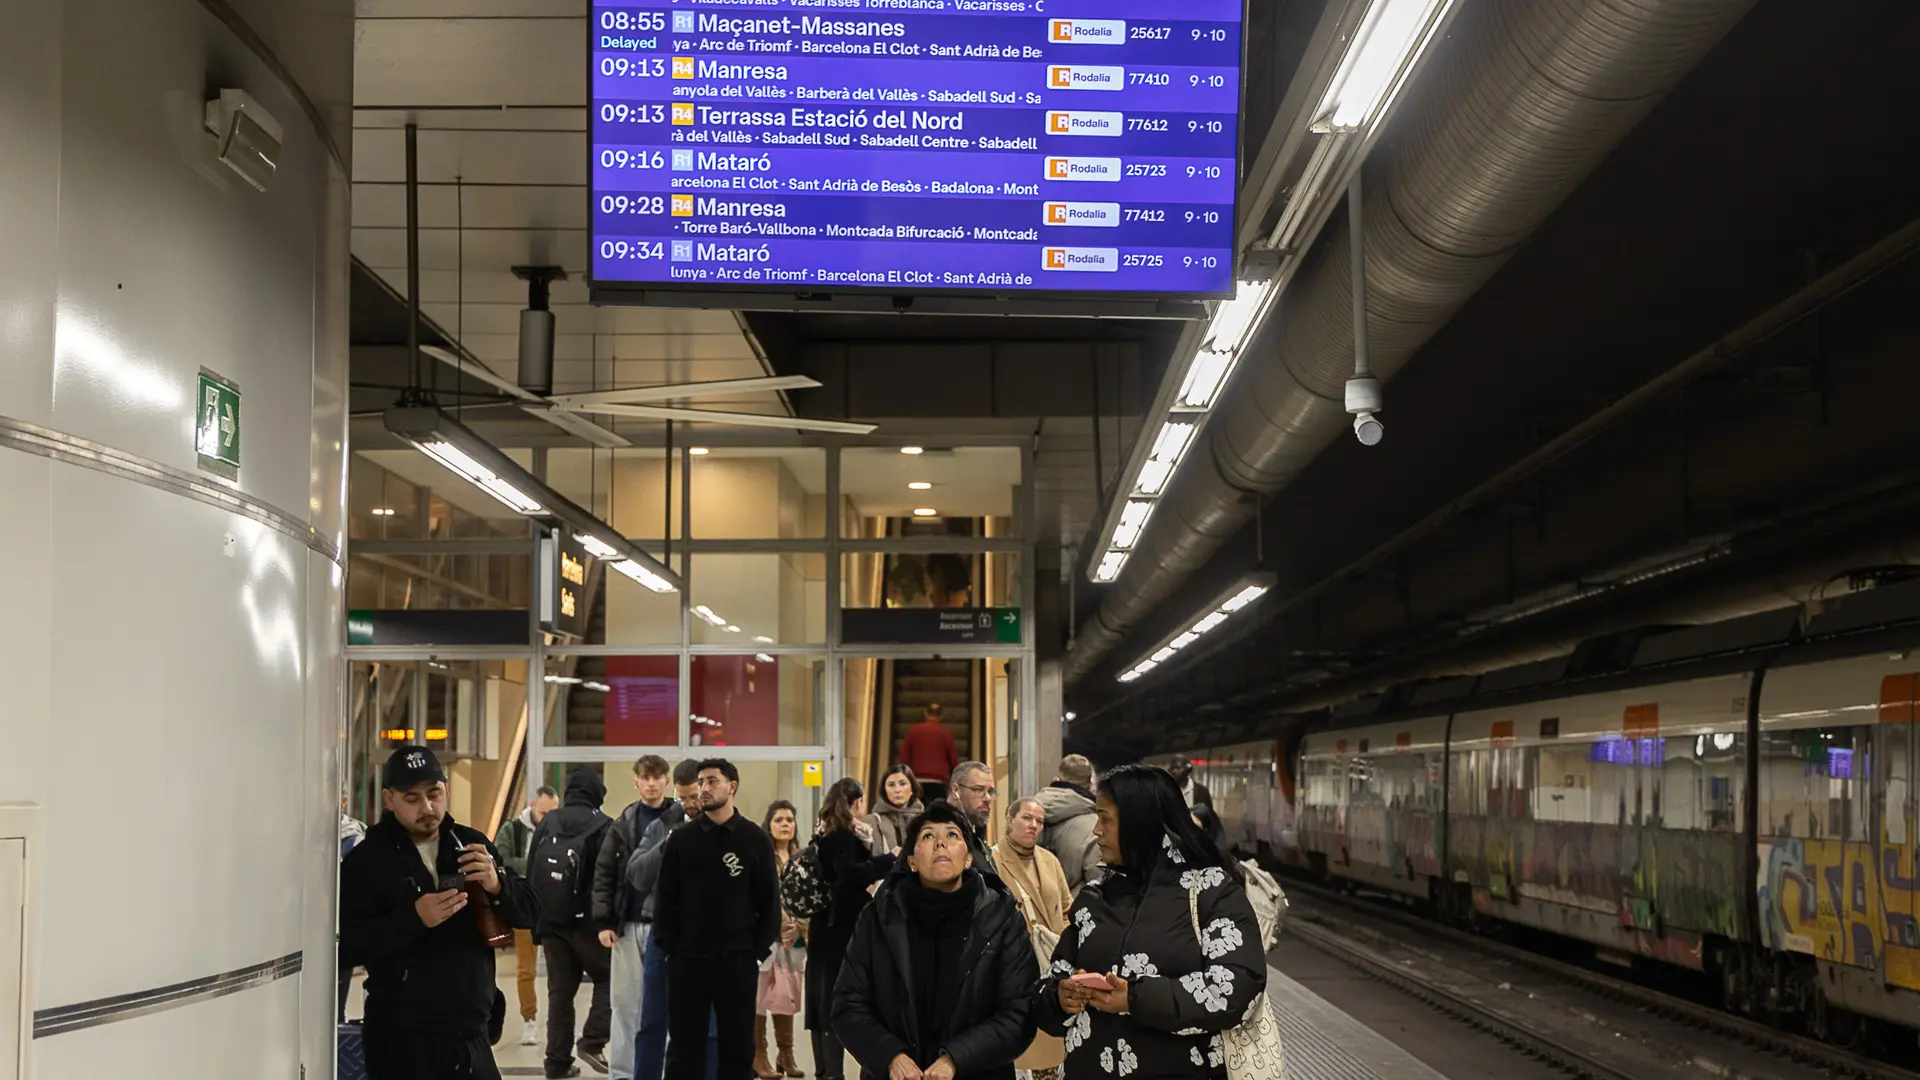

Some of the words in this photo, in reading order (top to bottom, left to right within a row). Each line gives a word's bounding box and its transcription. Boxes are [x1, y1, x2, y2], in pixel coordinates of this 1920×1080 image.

[955, 0, 1025, 11] Vacarisses
[601, 12, 665, 30] 08:55
[675, 16, 692, 29] R1
[699, 14, 905, 37] Maçanet-Massanes
[1075, 27, 1111, 36] Rodalia
[1131, 27, 1171, 39] 25617
[601, 36, 656, 51] Delayed
[699, 38, 724, 50] Arc
[727, 39, 744, 50] de
[747, 40, 792, 52] Triomf
[802, 41, 870, 54] Barcelona
[874, 42, 887, 54] El
[890, 43, 920, 55] Clot
[930, 44, 961, 56] Sant
[963, 45, 1000, 57] Adrià
[1002, 46, 1020, 57] de
[601, 58, 664, 76] 09:13
[673, 62, 693, 75] R4
[699, 60, 787, 80] Manresa
[1074, 73, 1110, 82] Rodalia
[1129, 73, 1169, 85] 77410
[673, 84, 718, 98] anyola
[721, 85, 743, 97] del
[746, 86, 786, 98] Vallès
[797, 87, 850, 99] Barberà
[852, 88, 875, 100] del
[878, 89, 918, 101] Vallès
[928, 90, 987, 102] Sabadell
[990, 91, 1015, 103] Sud
[601, 104, 664, 123] 09:13
[672, 108, 693, 121] R4
[697, 106, 785, 126] Terrassa
[792, 109, 868, 127] Estació
[873, 110, 907, 128] del
[913, 111, 962, 130] Nord
[1072, 119, 1108, 127] Rodalia
[1128, 119, 1168, 131] 77612
[672, 129, 683, 141] rà
[686, 130, 708, 142] del
[711, 131, 752, 143] Vallès
[763, 132, 821, 144] Sabadell
[824, 133, 850, 145] Sud
[860, 134, 919, 147] Sabadell
[922, 136, 969, 148] Centre
[979, 137, 1037, 149] Sabadell
[601, 150, 664, 168] 09:16
[674, 154, 691, 166] R1
[698, 152, 771, 171] Mataró
[1071, 164, 1107, 173] Rodalia
[1126, 164, 1166, 176] 25723
[672, 176, 729, 188] arcelona
[733, 177, 746, 188] El
[749, 177, 778, 189] Clot
[789, 178, 819, 190] Sant
[822, 179, 858, 191] Adrià
[861, 180, 878, 191] de
[882, 180, 921, 192] Besòs
[932, 181, 993, 194] Badalona
[1004, 183, 1039, 195] Mont
[601, 196, 664, 214] 09:28
[672, 199, 692, 212] R4
[698, 198, 785, 217] Manresa
[1070, 210, 1106, 218] Rodalia
[1125, 210, 1164, 221] 77412
[682, 221, 717, 233] Torre
[721, 222, 816, 235] Baró-Vallbona
[827, 224, 893, 237] Montcada
[897, 226, 964, 238] Bifurcació
[601, 241, 664, 259] 09:34
[673, 245, 690, 257] R1
[698, 243, 770, 262] Mataró
[1068, 255, 1104, 263] Rodalia
[1123, 255, 1163, 266] 25725
[671, 266, 706, 280] lunya
[717, 267, 740, 279] Arc
[743, 268, 760, 279] de
[764, 268, 807, 280] Triomf
[818, 270, 884, 282] Barcelona
[888, 271, 901, 282] El
[904, 271, 933, 283] Clot
[944, 272, 974, 283] Sant
[977, 273, 1012, 284] Adrià
[1015, 273, 1032, 285] de
